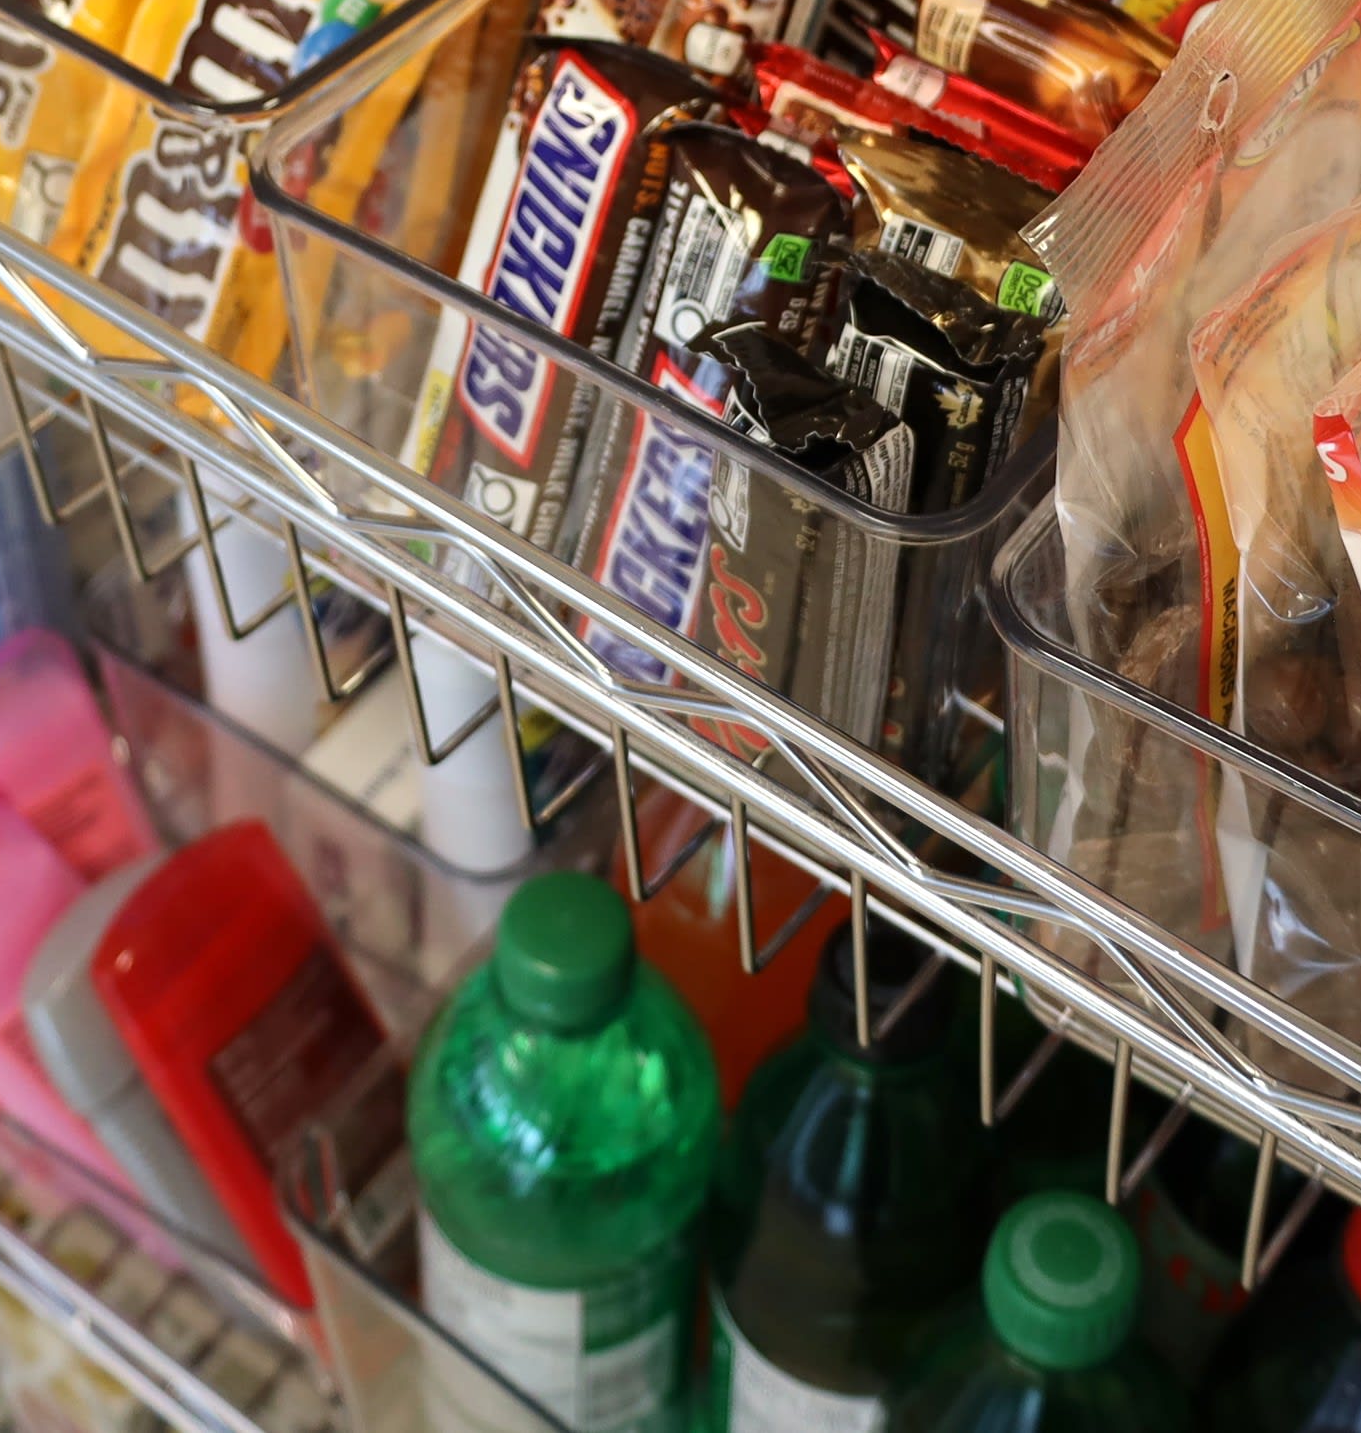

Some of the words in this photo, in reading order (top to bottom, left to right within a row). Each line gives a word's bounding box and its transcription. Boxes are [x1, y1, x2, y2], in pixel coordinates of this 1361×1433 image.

[775, 239, 802, 277] 250
[1015, 272, 1044, 315] 250
[1220, 579, 1241, 698] MACARONS
